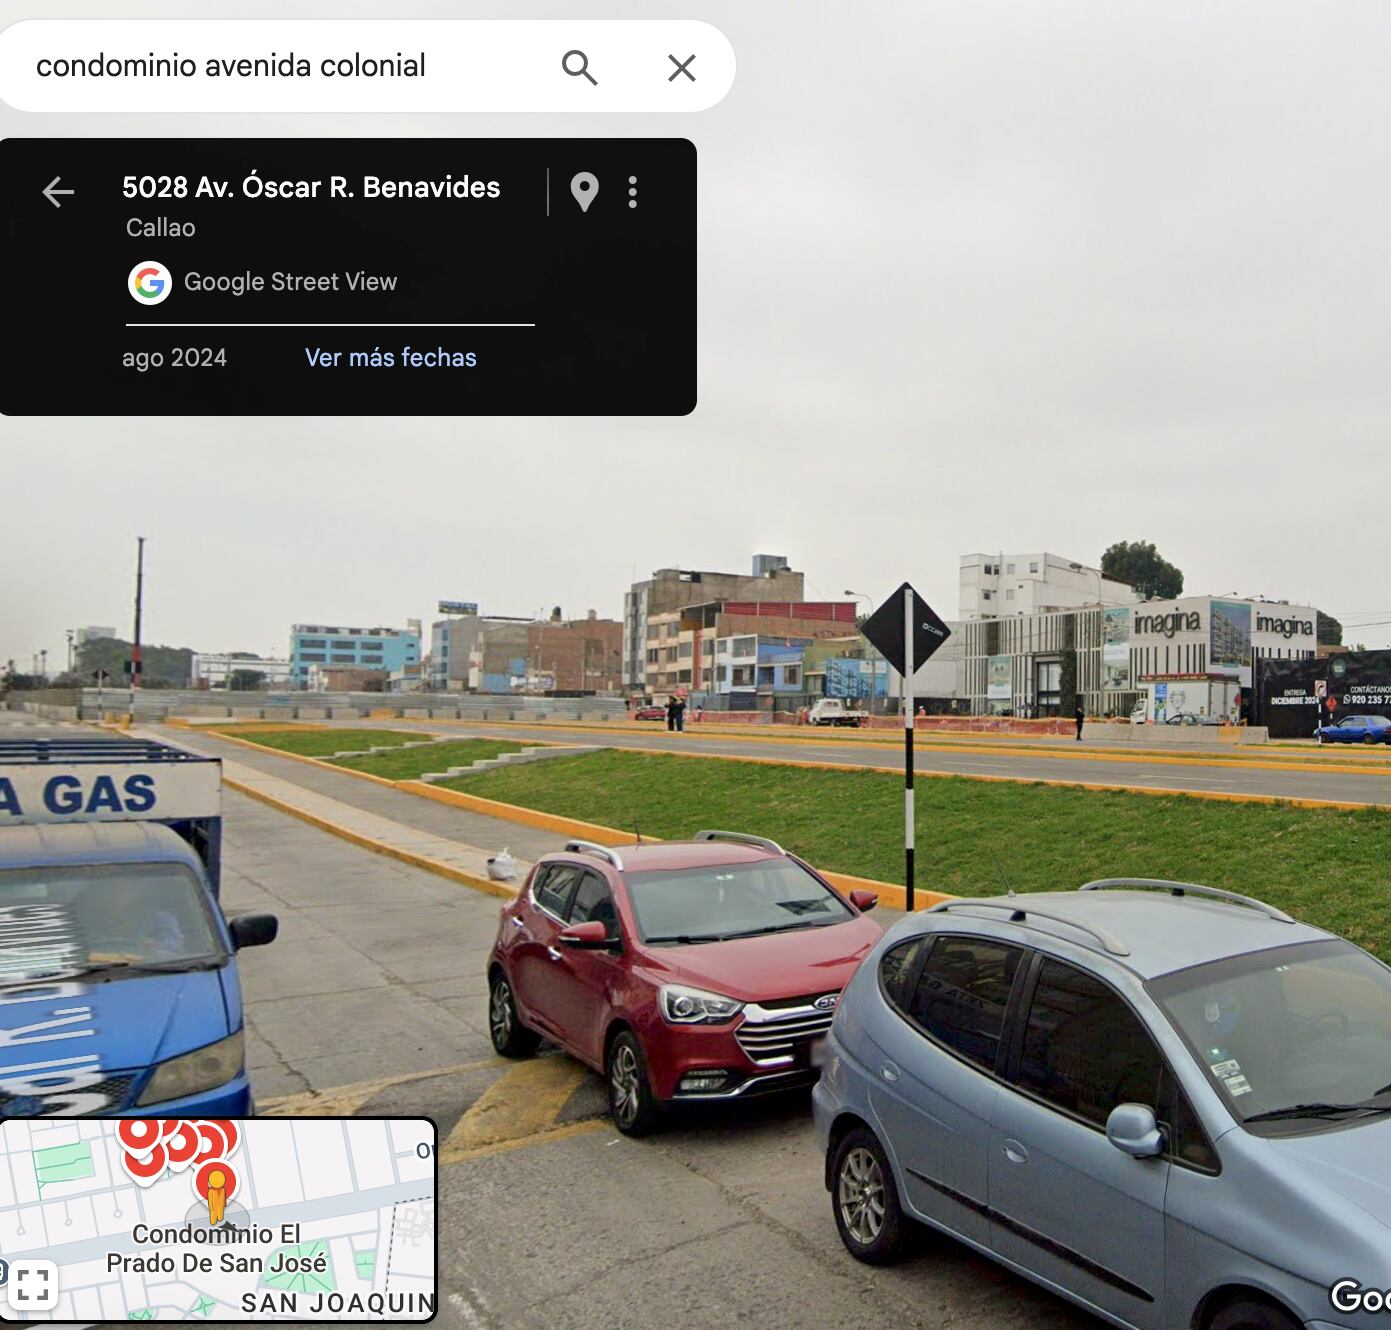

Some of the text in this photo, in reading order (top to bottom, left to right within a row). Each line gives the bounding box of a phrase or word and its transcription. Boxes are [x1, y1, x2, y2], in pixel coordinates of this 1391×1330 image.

[1134, 607, 1200, 638] imagina
[1256, 611, 1313, 639] imagina
[1271, 697, 1304, 705] DICIEMBRE
[1284, 689, 1307, 697] ENTREGA
[1352, 696, 1365, 705] 920
[1368, 696, 1382, 705] 235
[43, 775, 156, 813] GAS
